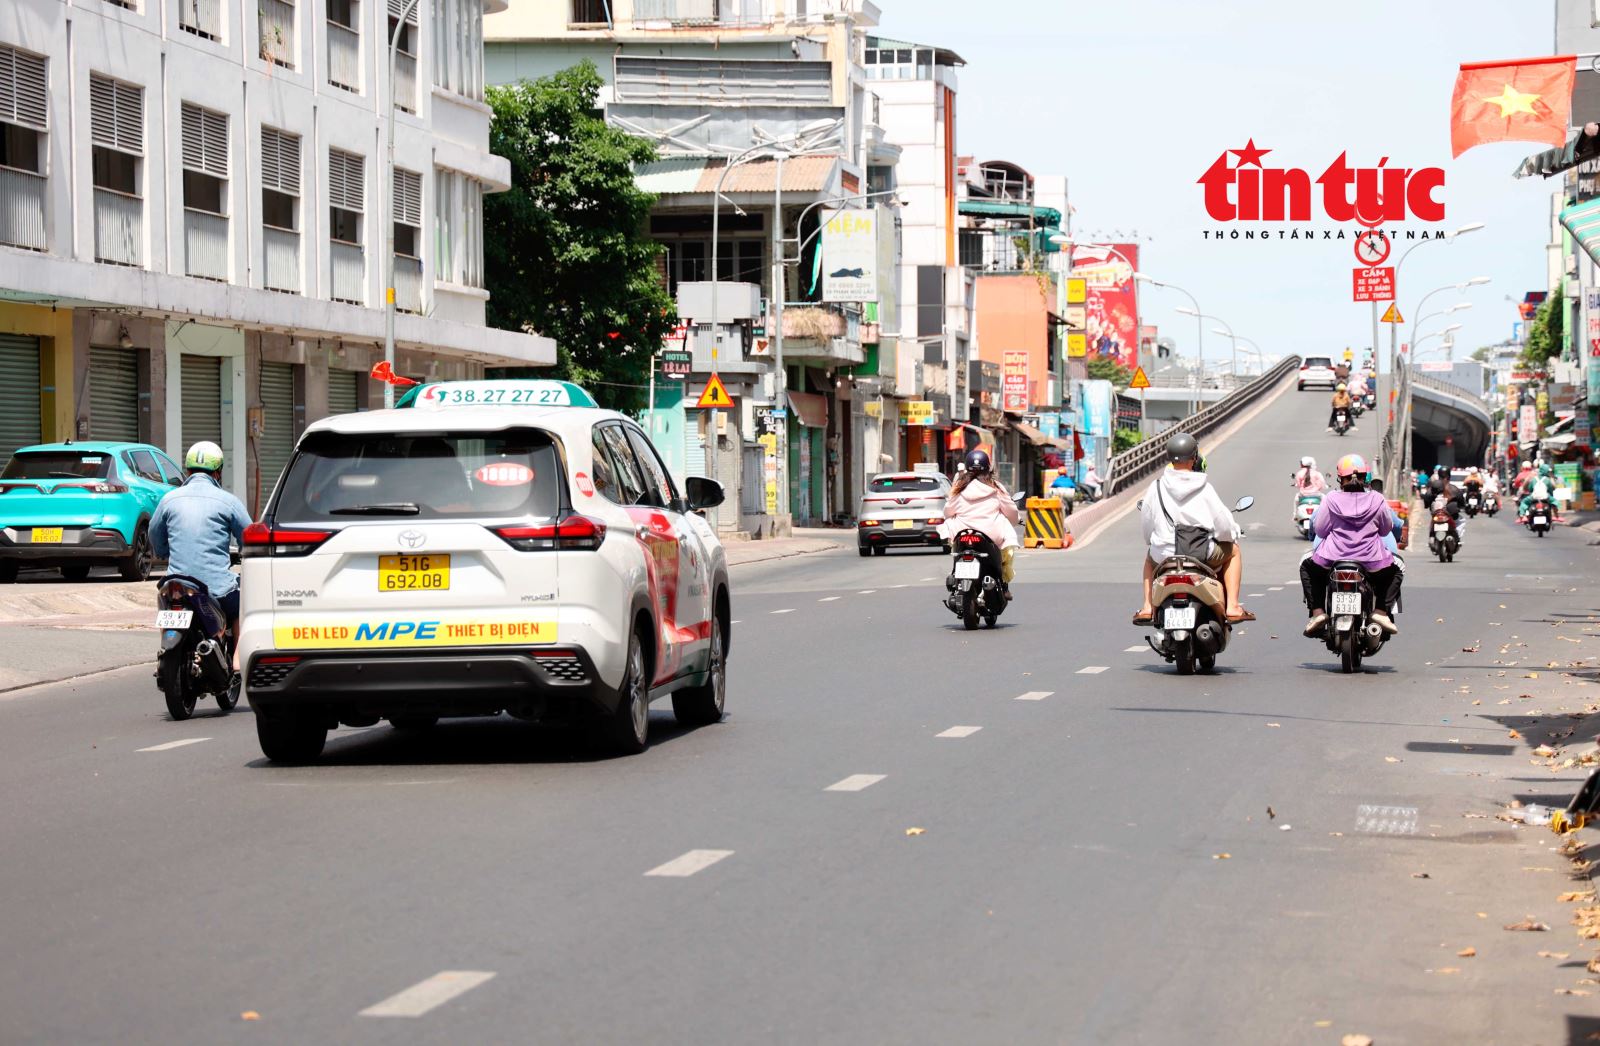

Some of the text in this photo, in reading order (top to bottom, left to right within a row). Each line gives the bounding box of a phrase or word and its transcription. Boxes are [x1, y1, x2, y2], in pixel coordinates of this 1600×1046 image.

[827, 212, 872, 238] NỆM
[1362, 268, 1386, 278] CẤM
[664, 362, 690, 372] LÊ LAI
[453, 389, 562, 403] 38.27 27 27
[399, 557, 430, 572] 51G
[387, 574, 441, 589] 692.08
[324, 626, 348, 640] LED
[354, 621, 440, 641] MPE
[490, 624, 504, 639] BỊ
[508, 622, 539, 638] ĐIỆN
